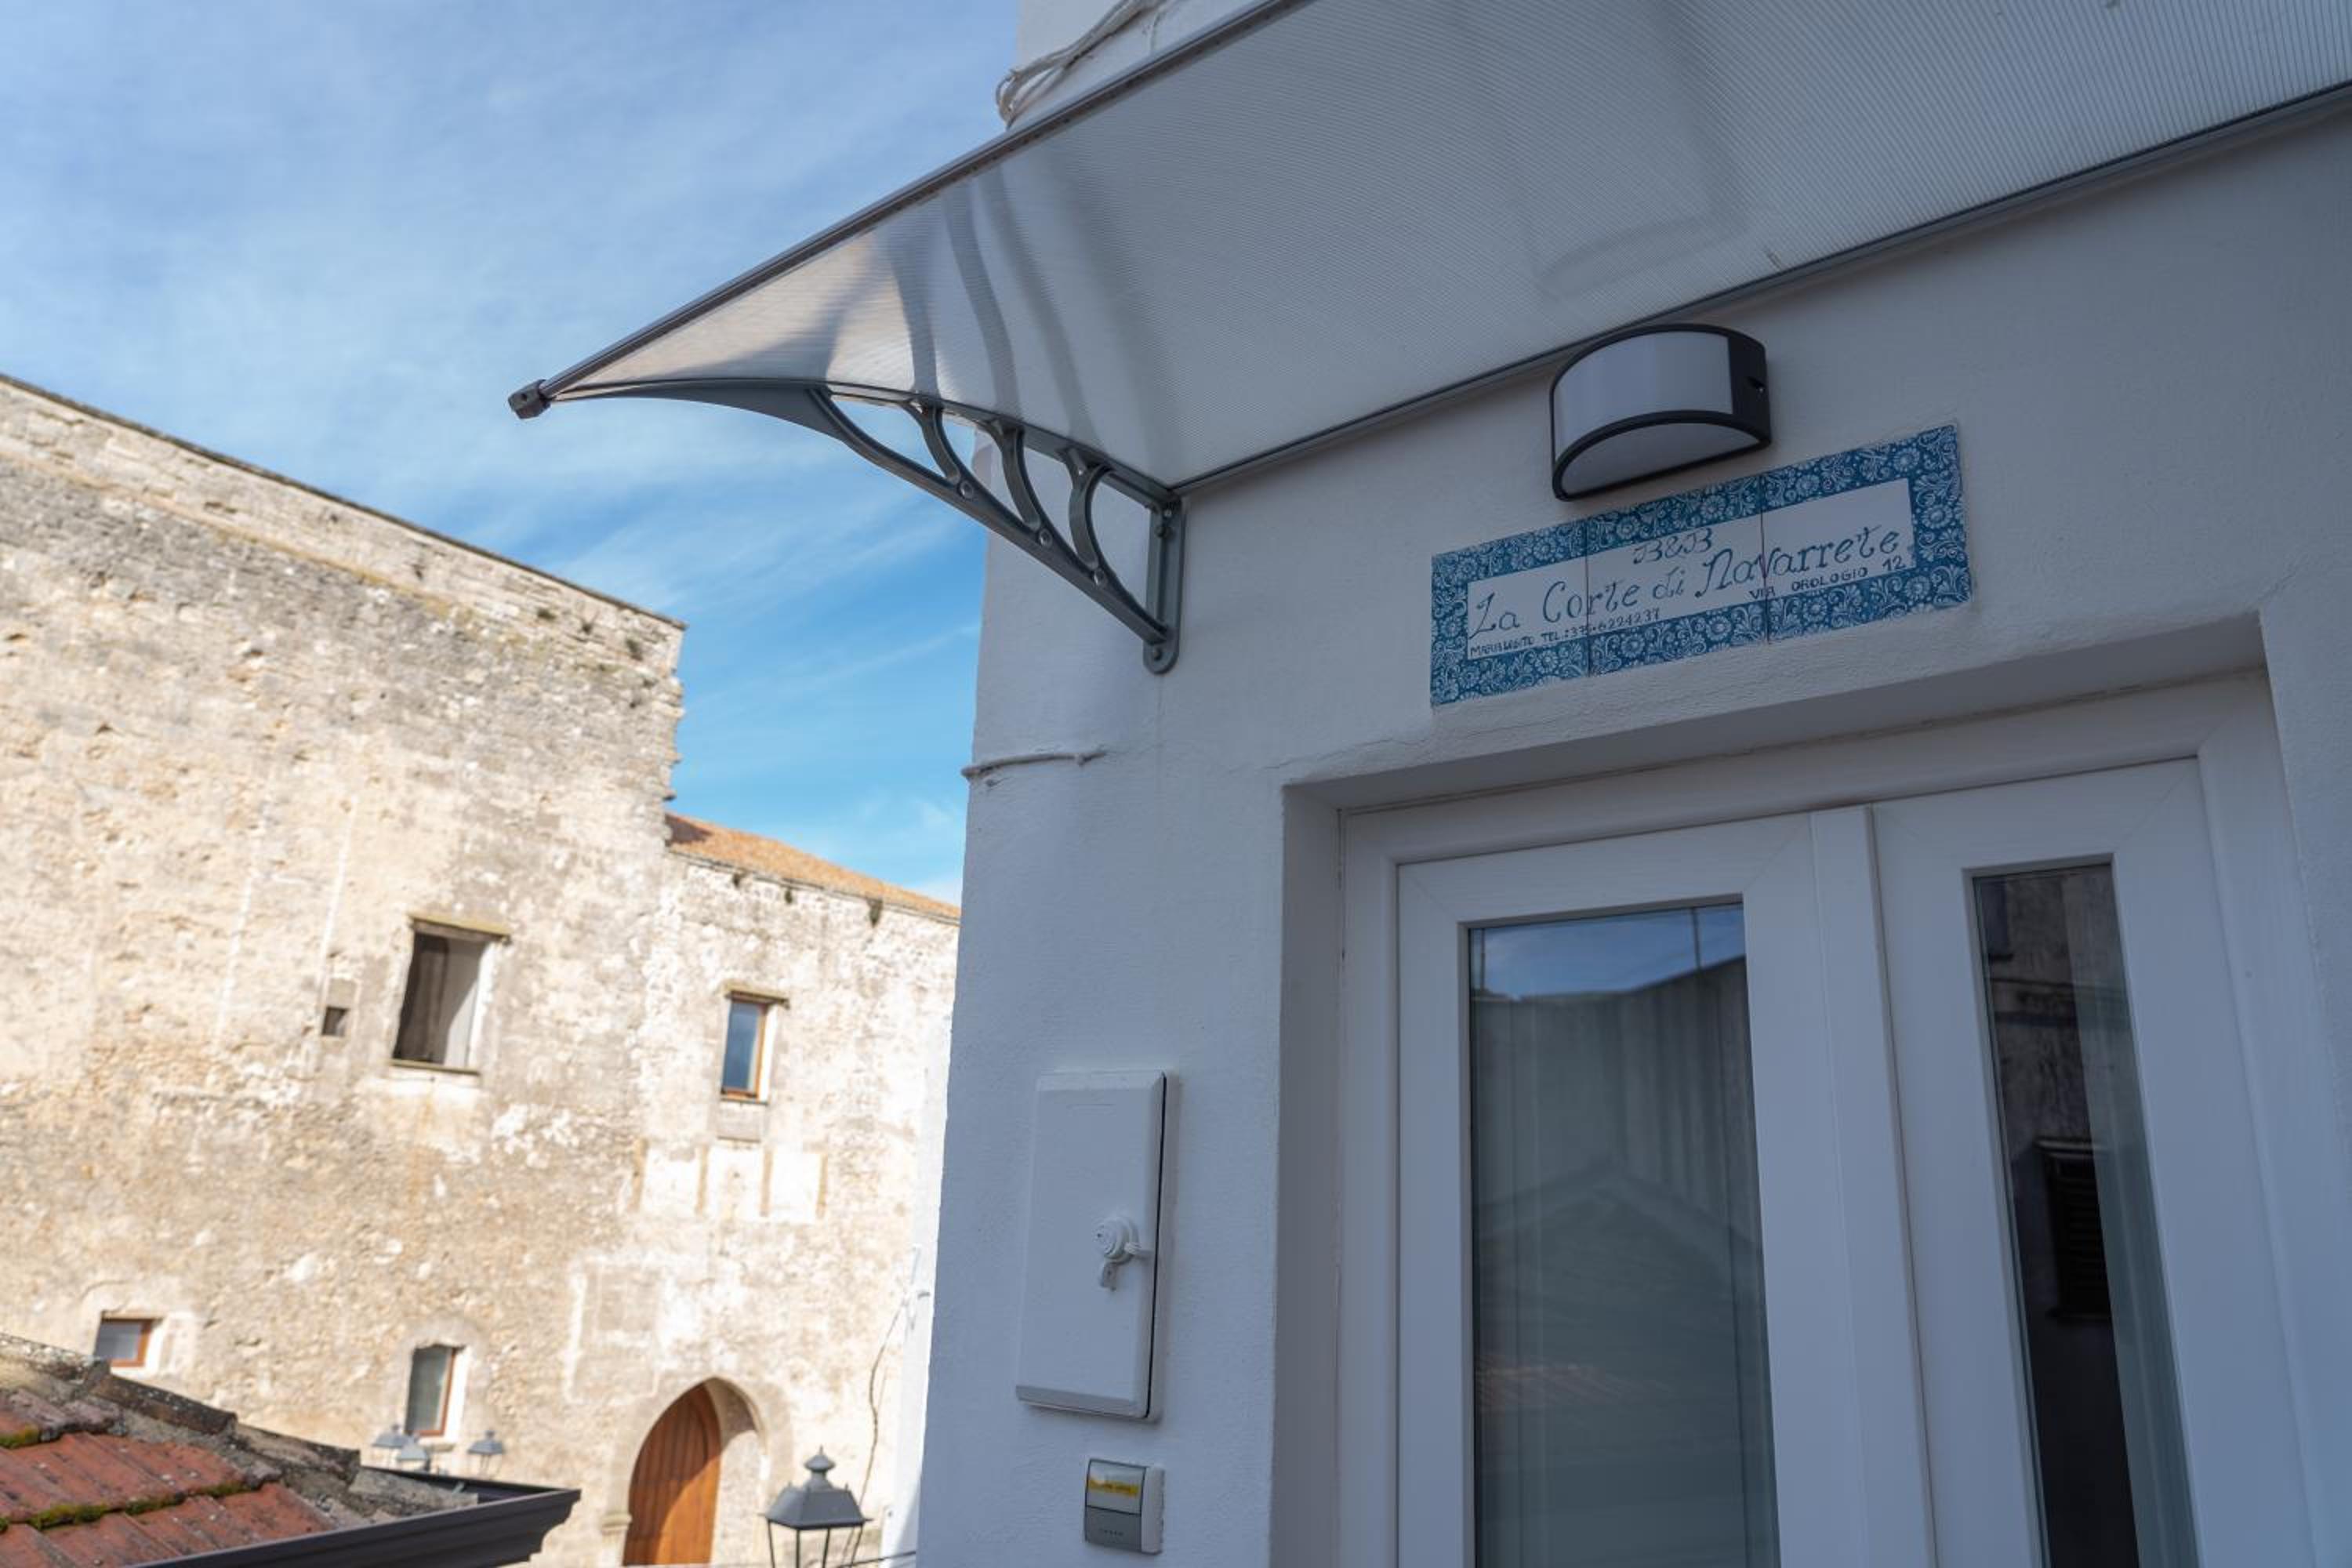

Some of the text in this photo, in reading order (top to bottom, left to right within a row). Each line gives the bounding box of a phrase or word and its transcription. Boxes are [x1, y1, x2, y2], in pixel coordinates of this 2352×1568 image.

[1633, 528, 1712, 564] B&B
[1469, 524, 1900, 640] La Corte di Navarrete
[1749, 554, 1906, 600] VIA OROLOGIO 12
